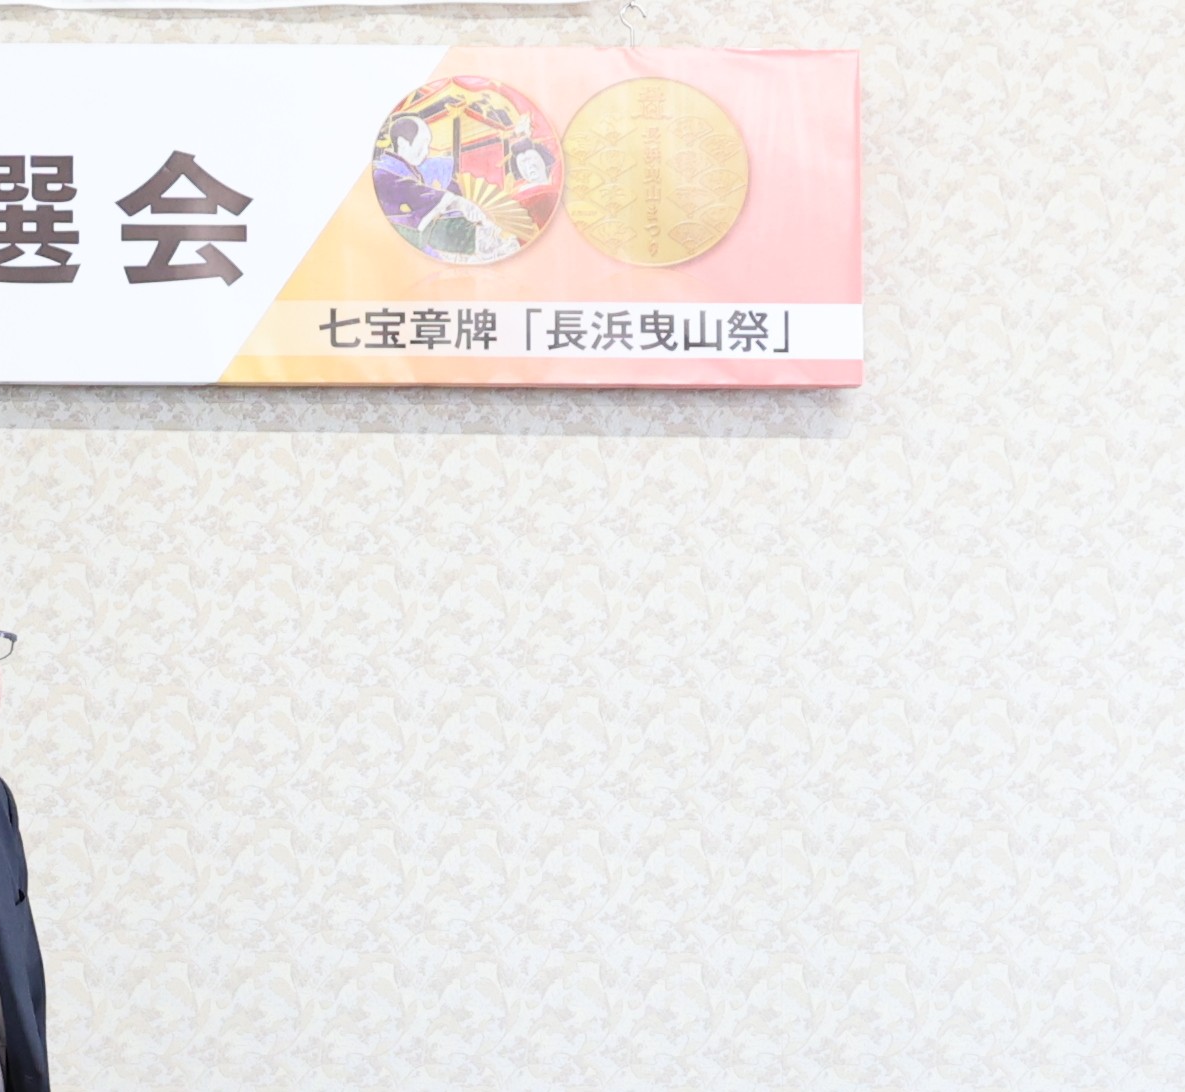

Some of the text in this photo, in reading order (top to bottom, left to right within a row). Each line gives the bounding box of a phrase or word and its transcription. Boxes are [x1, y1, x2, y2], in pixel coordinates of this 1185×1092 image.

[318, 306, 790, 355] 七宝章牌「長浜曳山祭」
